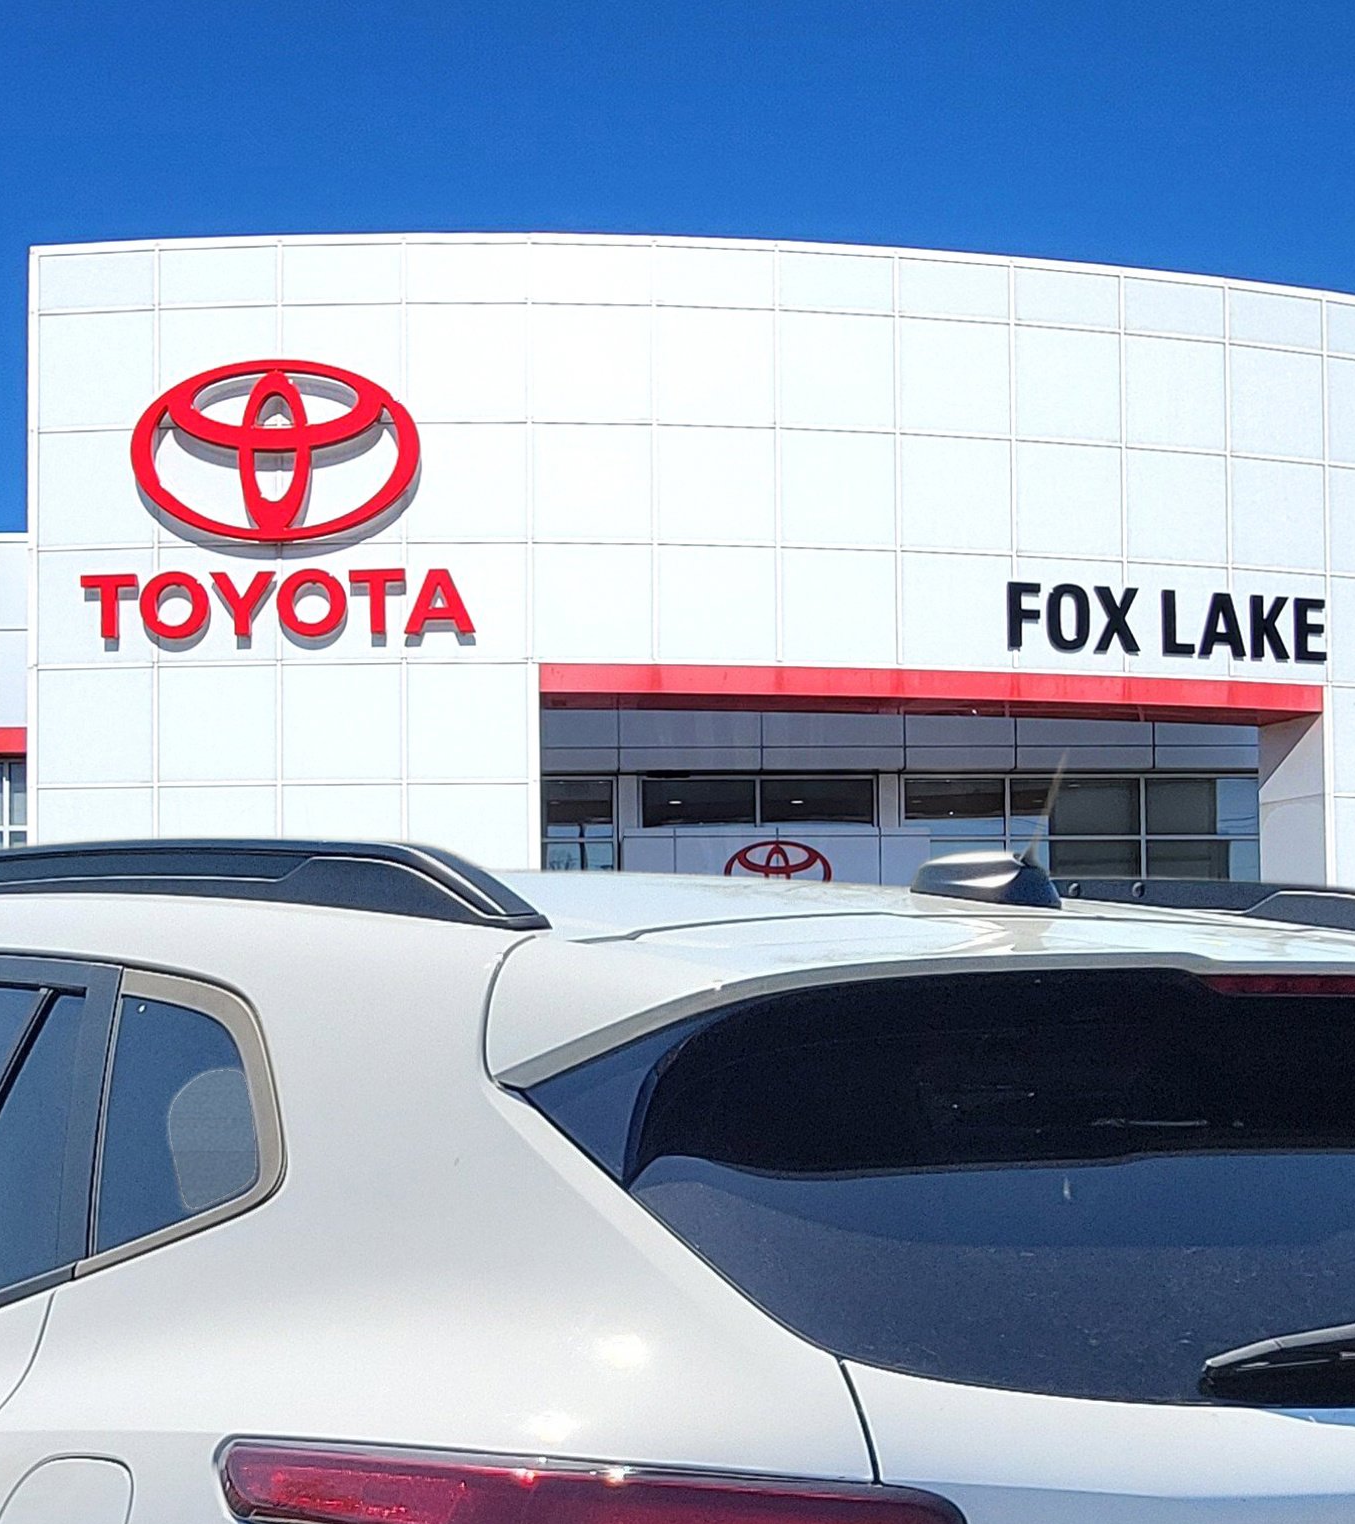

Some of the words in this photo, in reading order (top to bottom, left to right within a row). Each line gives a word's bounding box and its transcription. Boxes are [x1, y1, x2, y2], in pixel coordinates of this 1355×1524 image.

[80, 568, 477, 640] TOYOTA
[1006, 580, 1142, 654] FOX
[1160, 588, 1328, 663] LAKE
